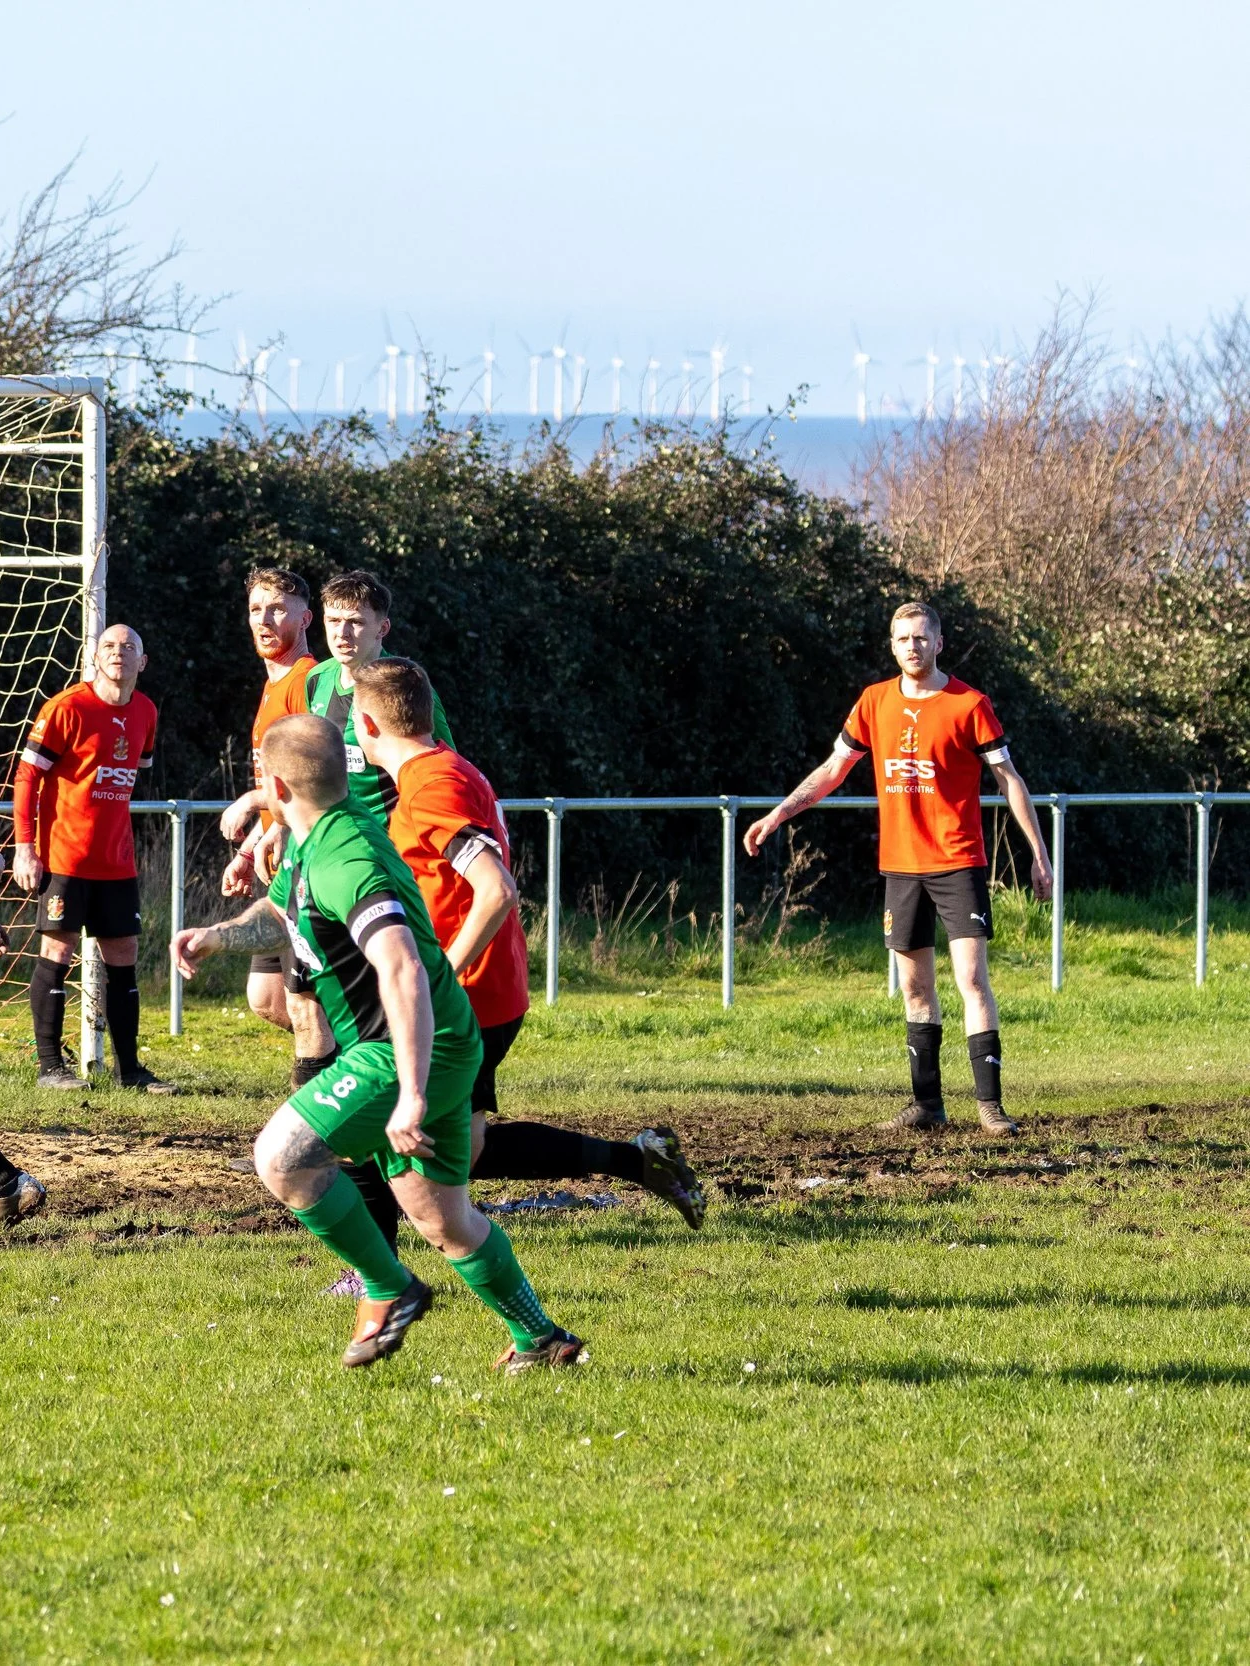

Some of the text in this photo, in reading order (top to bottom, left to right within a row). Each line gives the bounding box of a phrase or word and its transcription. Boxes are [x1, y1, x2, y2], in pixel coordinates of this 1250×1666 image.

[95, 765, 138, 787] PSS
[884, 758, 936, 779] PSS
[92, 790, 131, 801] AUTO CENT
[885, 785, 935, 795] AUTO CENTRE
[354, 905, 385, 930] APTAIN
[332, 1075, 357, 1098] 8
